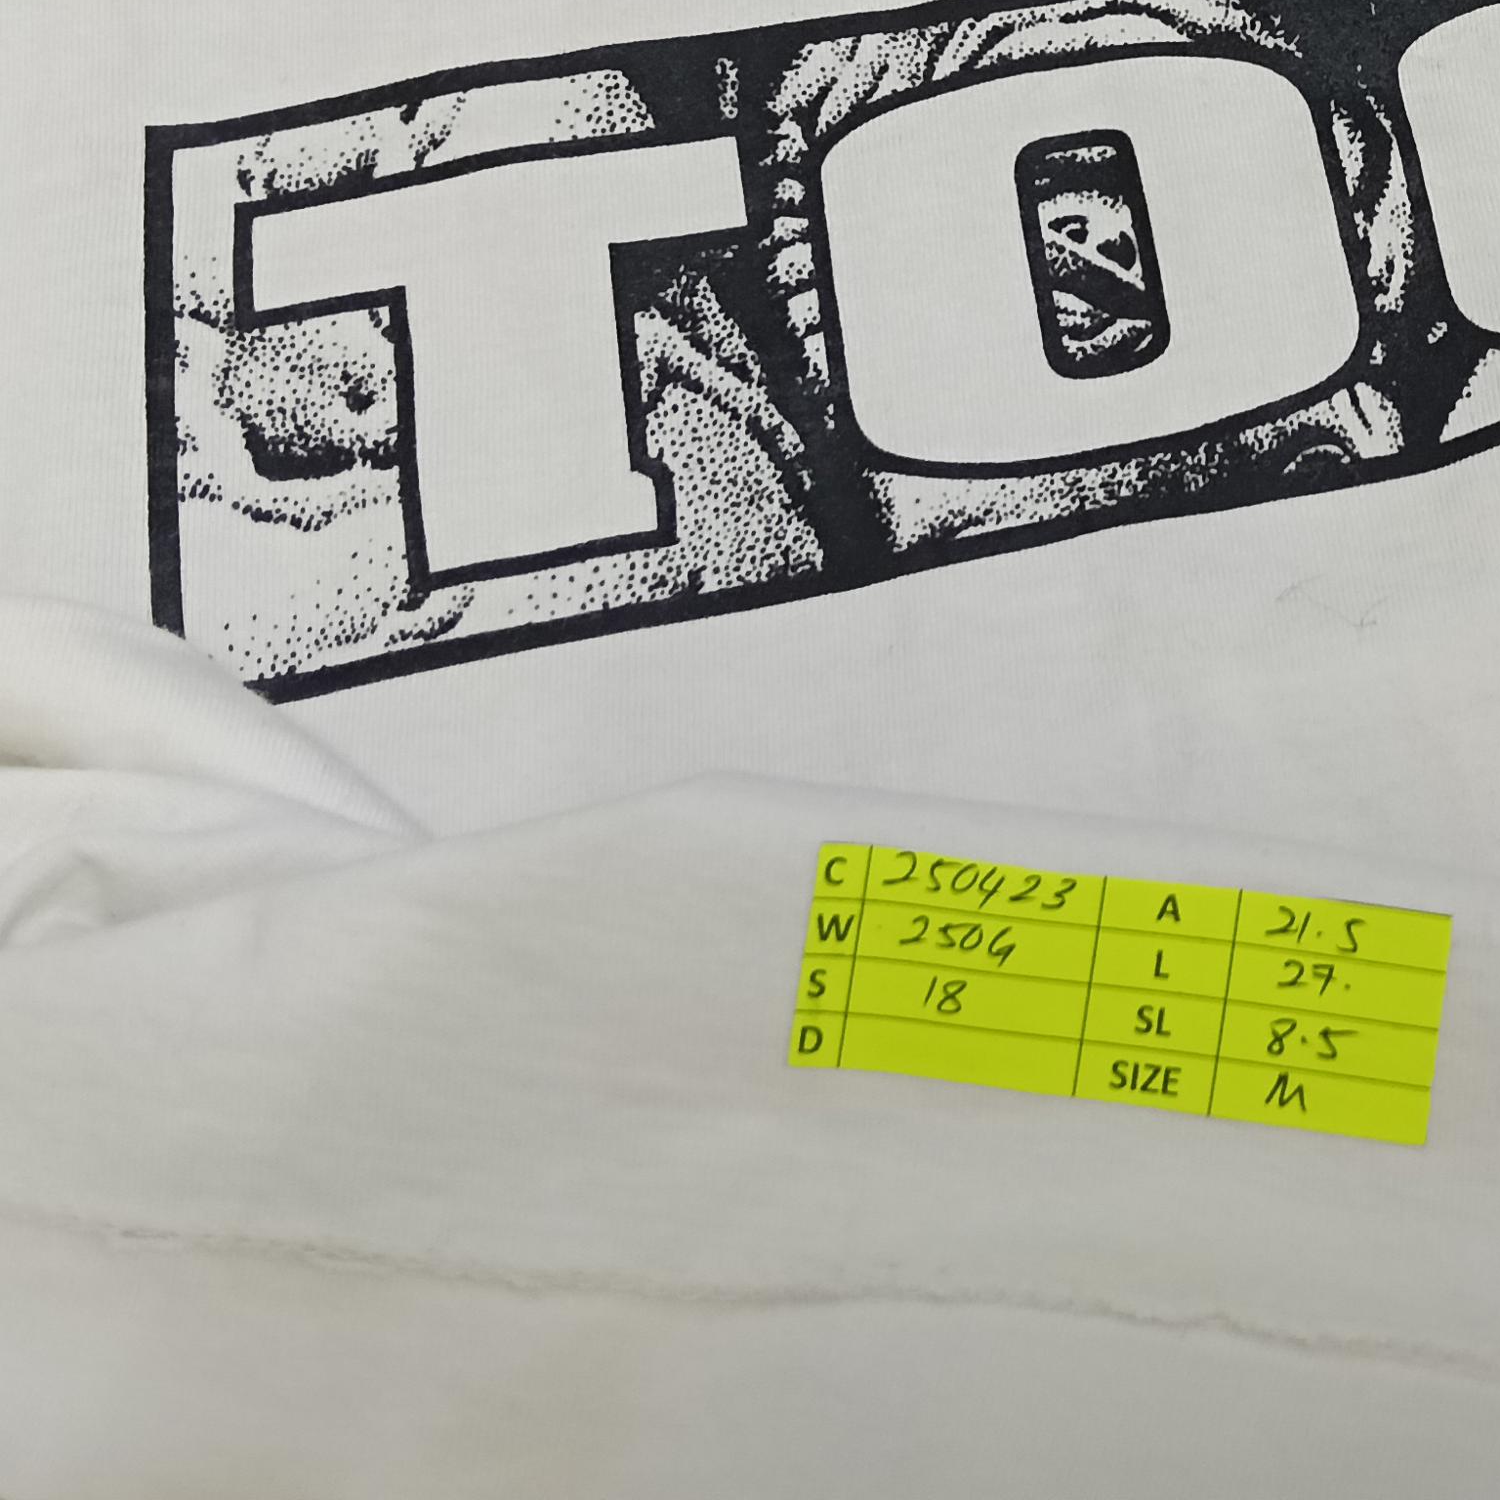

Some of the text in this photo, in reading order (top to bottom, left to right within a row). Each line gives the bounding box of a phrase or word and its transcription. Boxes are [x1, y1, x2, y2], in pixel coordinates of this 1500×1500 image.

[816, 913, 855, 941] W
[1153, 949, 1170, 980] L
[824, 850, 1367, 954] C 250423 A 21.5
[807, 968, 1360, 1061] S 18 SL 8.5
[798, 1025, 1307, 1113] D SIZE M
